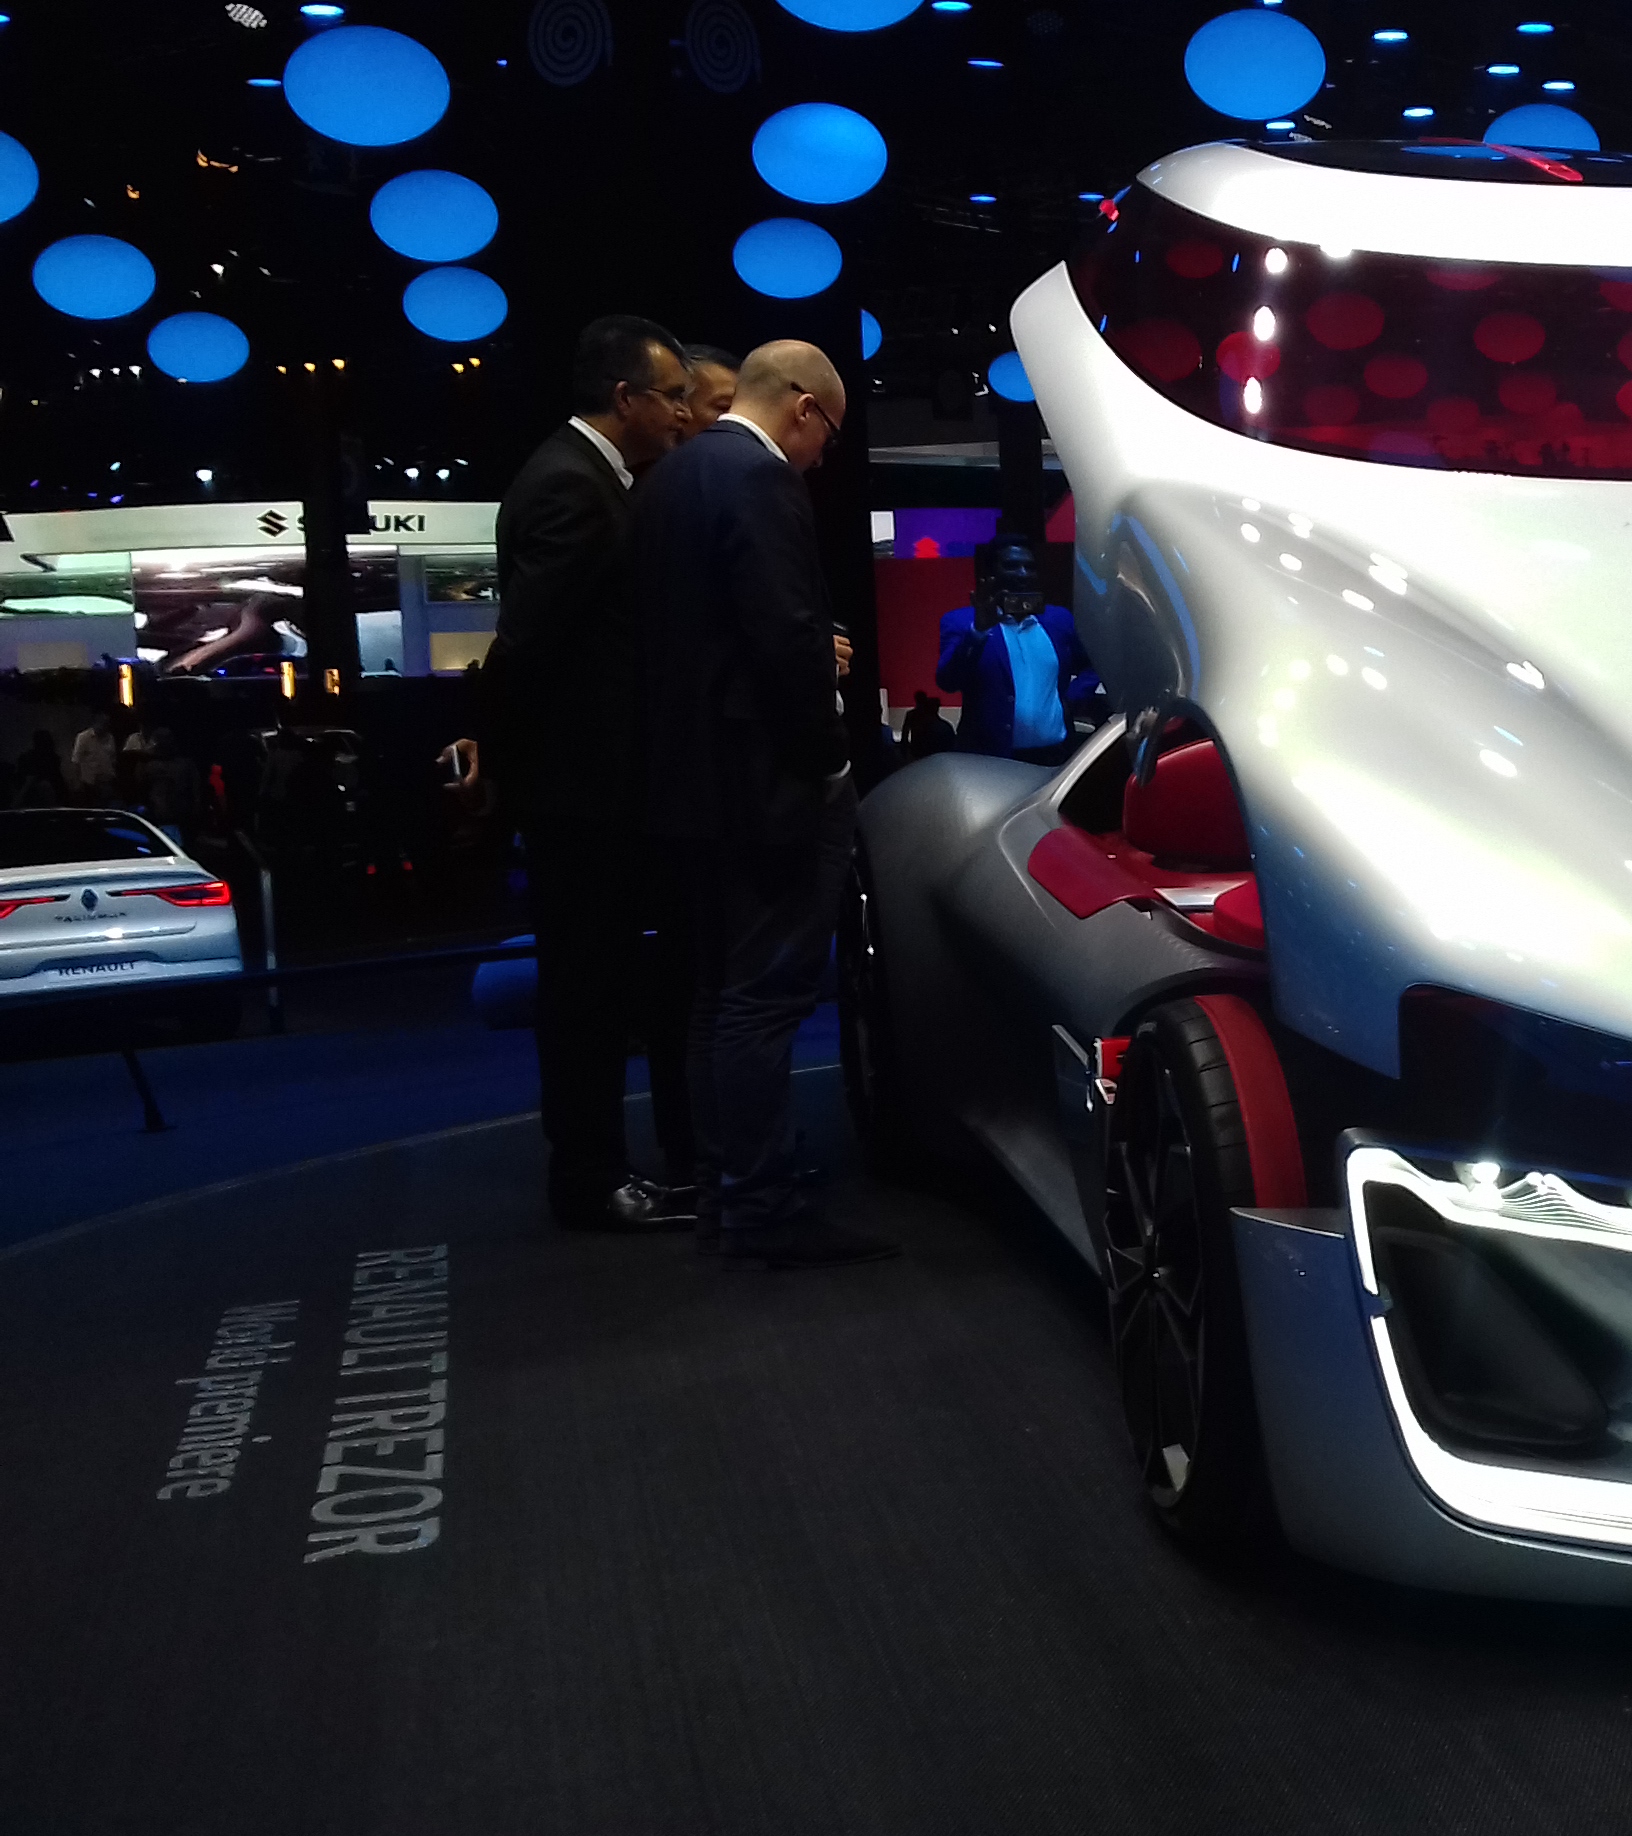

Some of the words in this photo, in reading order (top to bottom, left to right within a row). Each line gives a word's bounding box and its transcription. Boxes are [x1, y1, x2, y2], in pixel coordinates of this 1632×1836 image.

[57, 961, 136, 977] RENAULT
[205, 1300, 300, 1370] World
[340, 1244, 448, 1376] RENAULT
[156, 1371, 272, 1500] premiere
[303, 1379, 447, 1564] TREZOR
